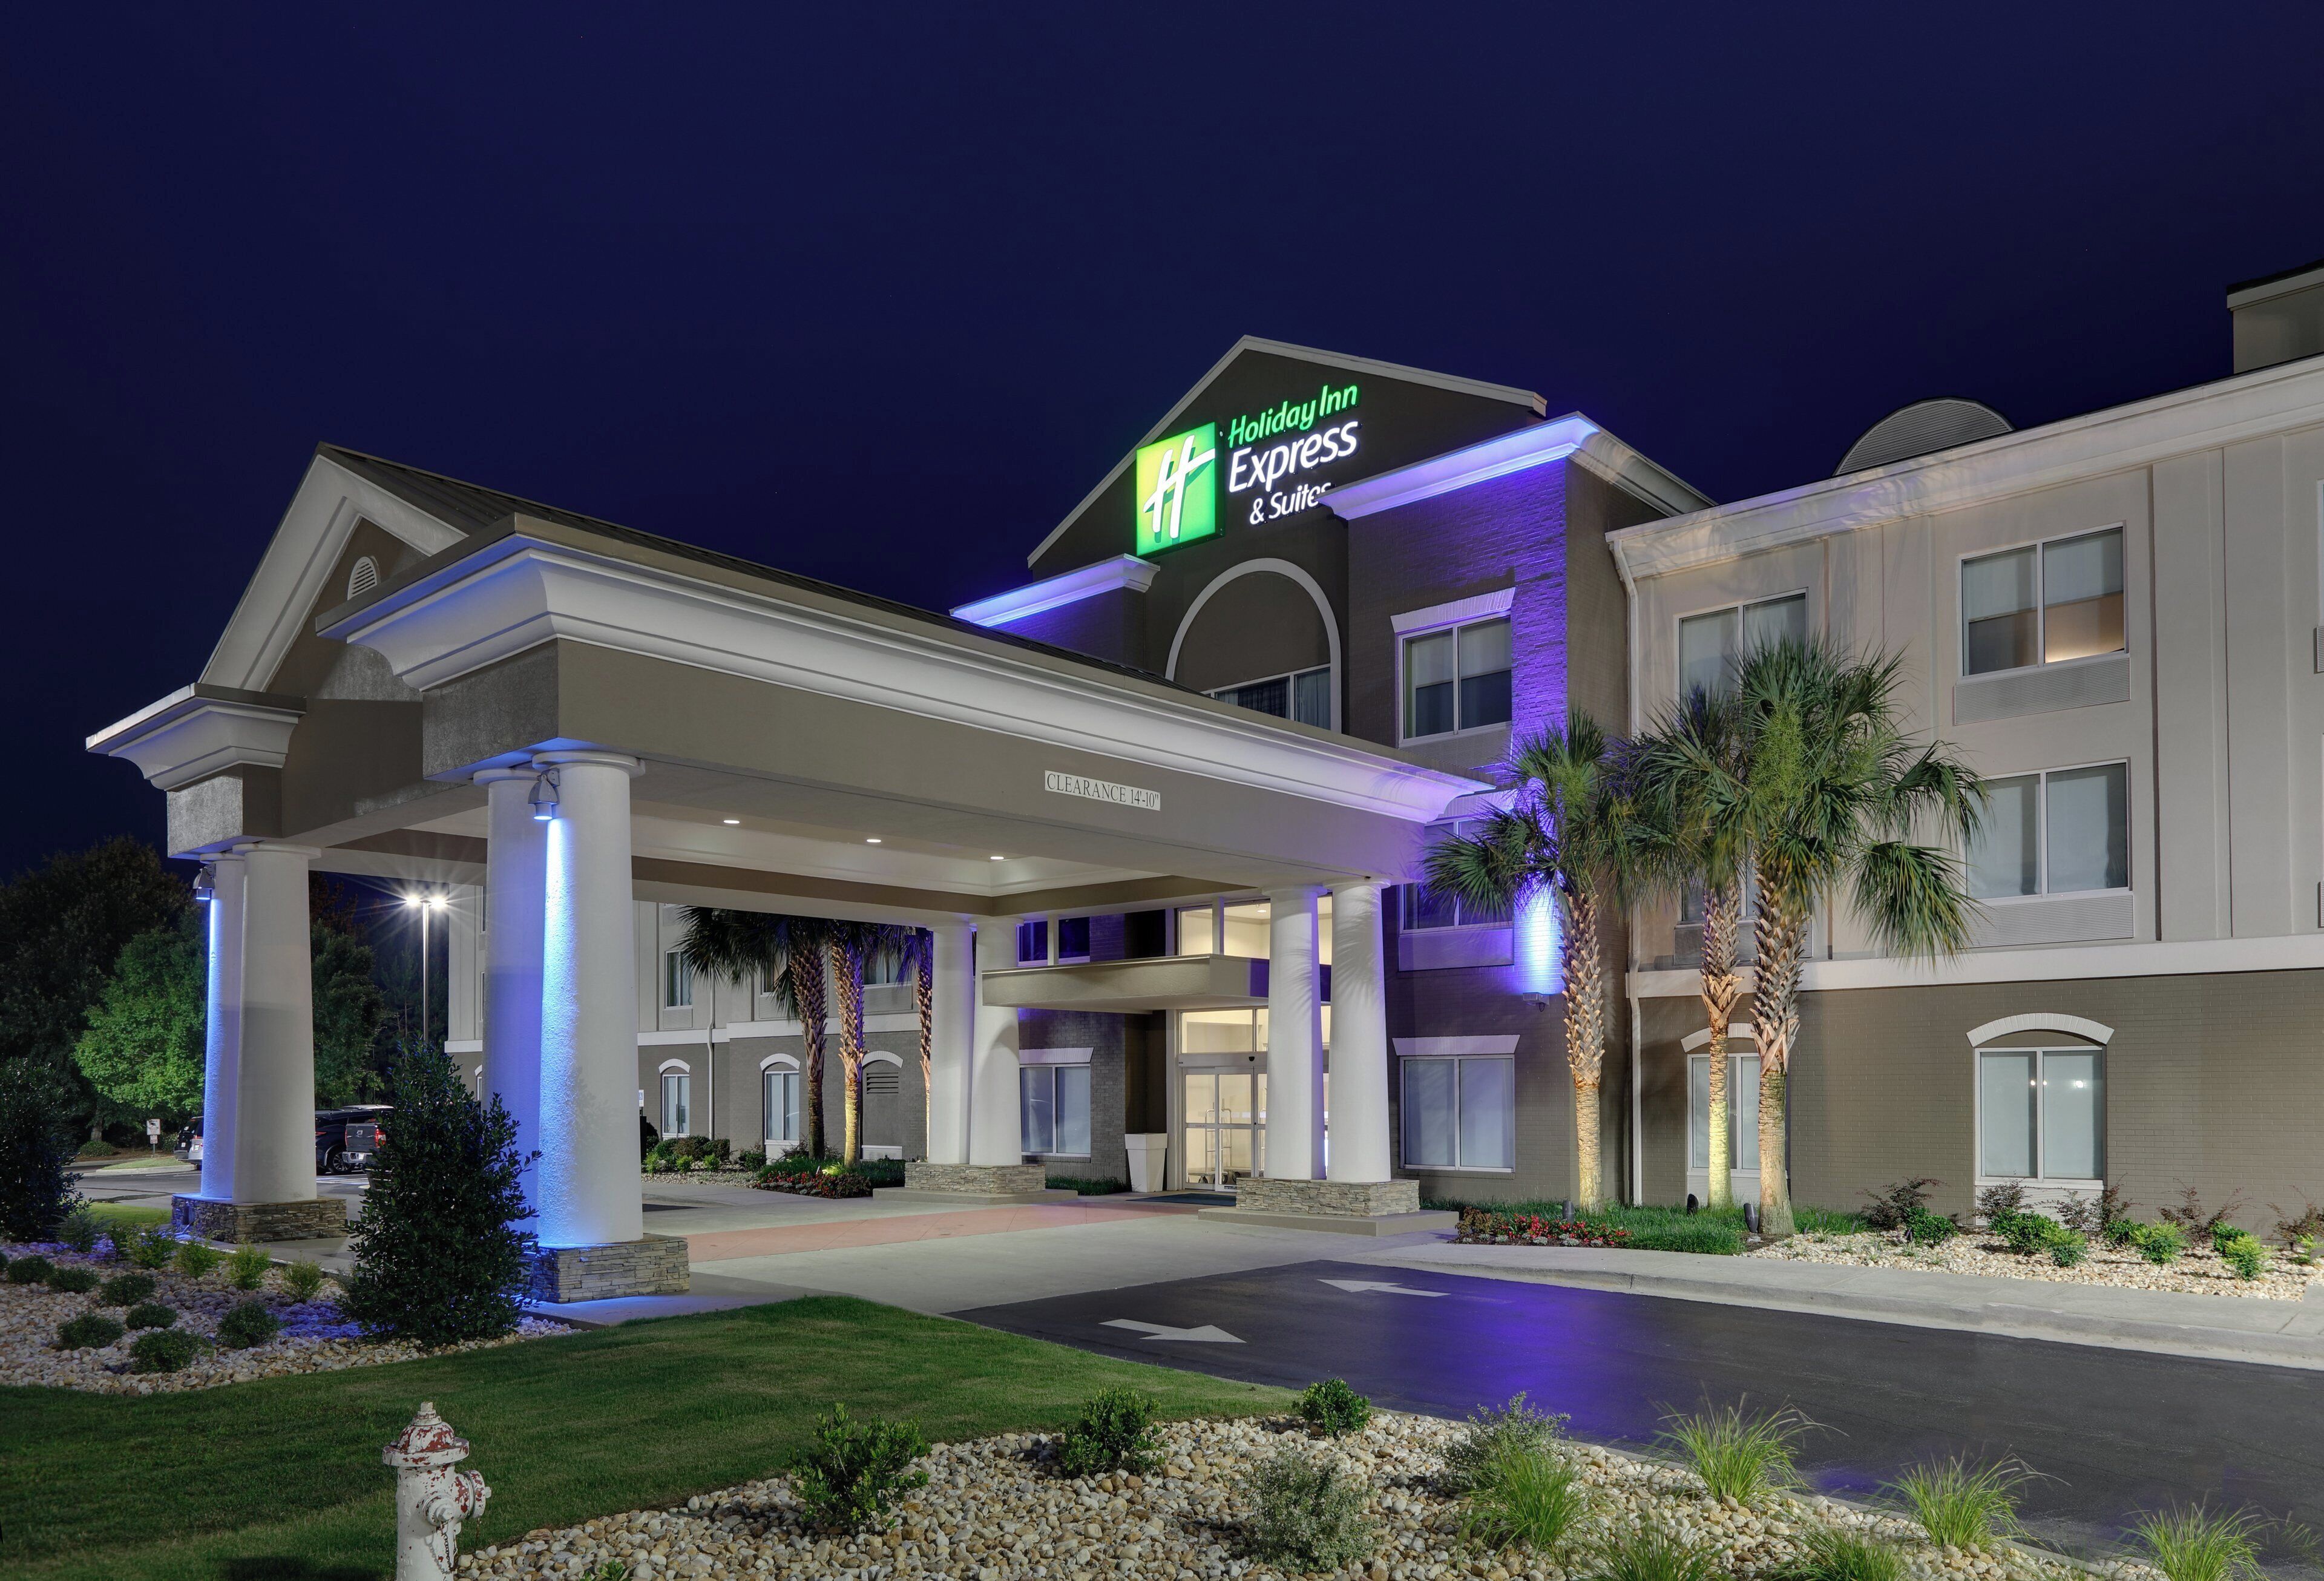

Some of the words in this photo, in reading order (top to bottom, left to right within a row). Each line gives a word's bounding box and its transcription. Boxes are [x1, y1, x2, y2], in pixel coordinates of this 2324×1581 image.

[1228, 399, 1316, 449] Holiday
[1319, 384, 1357, 417] Inn
[1229, 421, 1359, 493] Express
[1249, 498, 1265, 525] &
[1047, 773, 1126, 803] CLEARANCE
